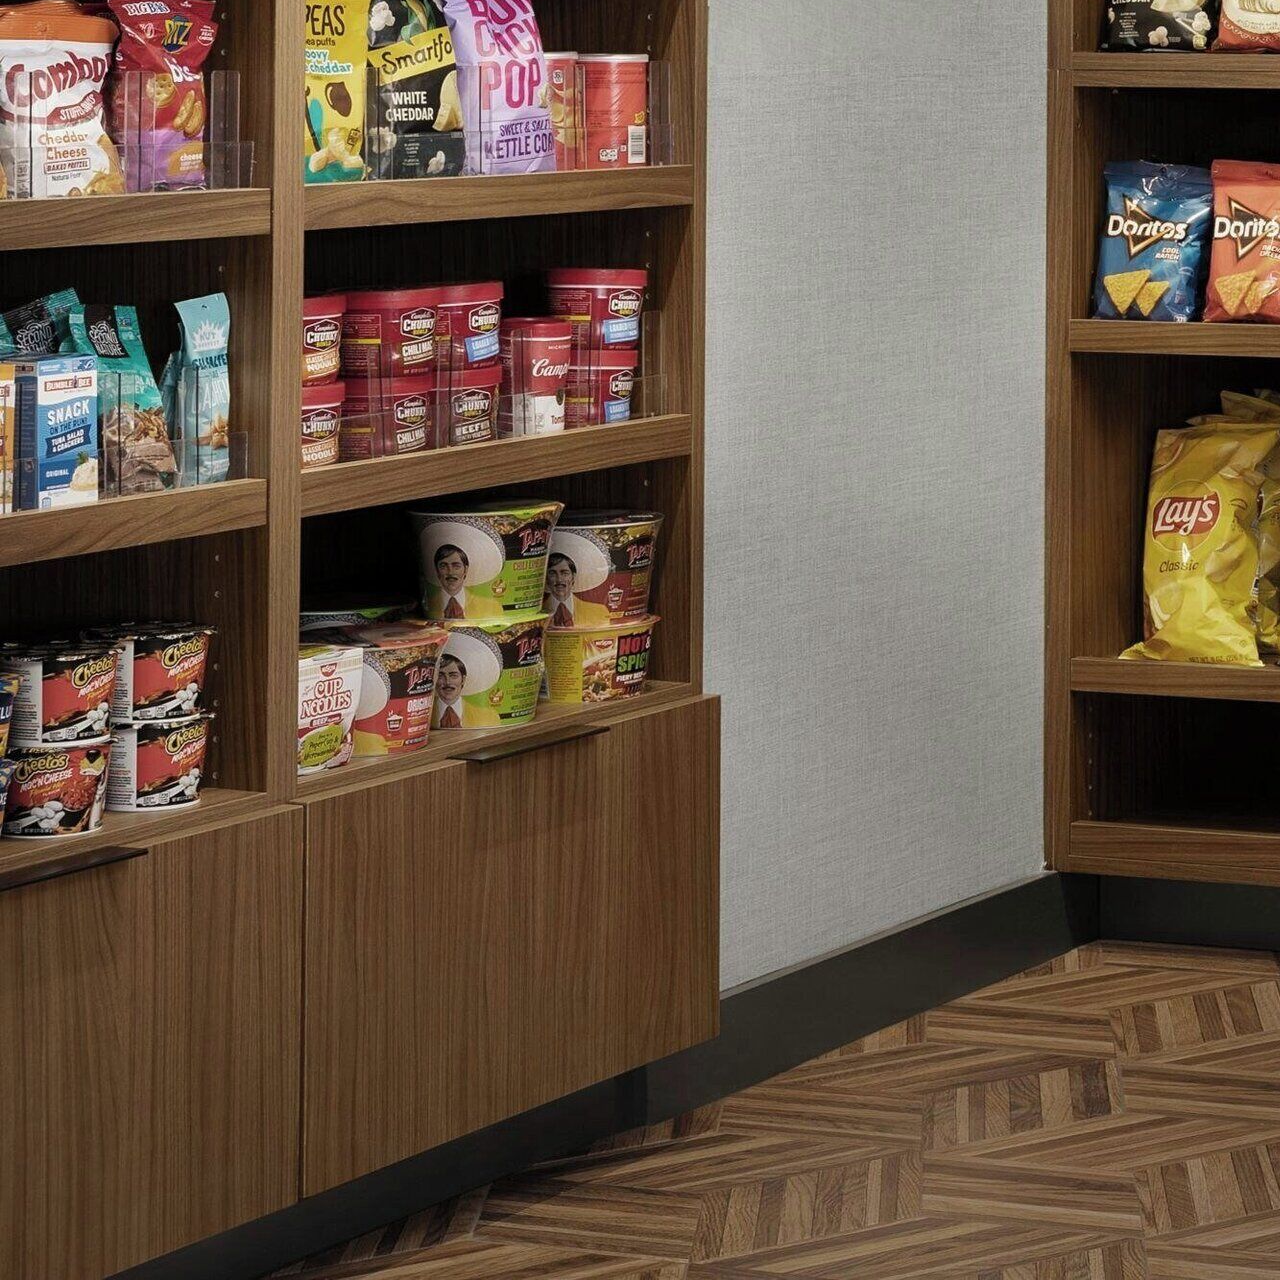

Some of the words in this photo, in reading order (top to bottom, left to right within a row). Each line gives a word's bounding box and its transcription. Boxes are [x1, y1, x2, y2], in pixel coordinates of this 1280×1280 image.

[162, 19, 193, 46] RITZ
[317, 38, 335, 46] puffs
[310, 62, 351, 73] cheddar
[480, 58, 541, 110] POP
[391, 91, 427, 107] WHITE
[386, 106, 434, 122] CHEDDAR
[500, 121, 524, 136] SWEET
[38, 132, 88, 145] Cheddar
[47, 147, 87, 160] Cheese
[485, 135, 531, 160] KETTLE
[68, 161, 88, 169] PRETZEL
[1107, 214, 1188, 241] Doritos
[1155, 253, 1181, 261] RANCH
[403, 319, 433, 331] CHUNKY
[89, 329, 118, 345] SECOND
[307, 331, 338, 343] CHUNKY
[94, 342, 125, 357] NATURE
[46, 379, 72, 391] BUMBLE
[78, 377, 92, 387] BEE
[47, 400, 90, 426] SNACK
[454, 399, 489, 412] CHUNKY
[60, 422, 71, 433] THE
[51, 436, 66, 446] TUNA
[67, 429, 84, 442] SALAD
[56, 436, 84, 452] CRACKERS
[45, 469, 69, 478] ORIGINAL
[1154, 496, 1217, 536] Lay's
[1159, 560, 1199, 574] Classic
[315, 677, 343, 699] CUP
[301, 690, 351, 718] NOODLES
